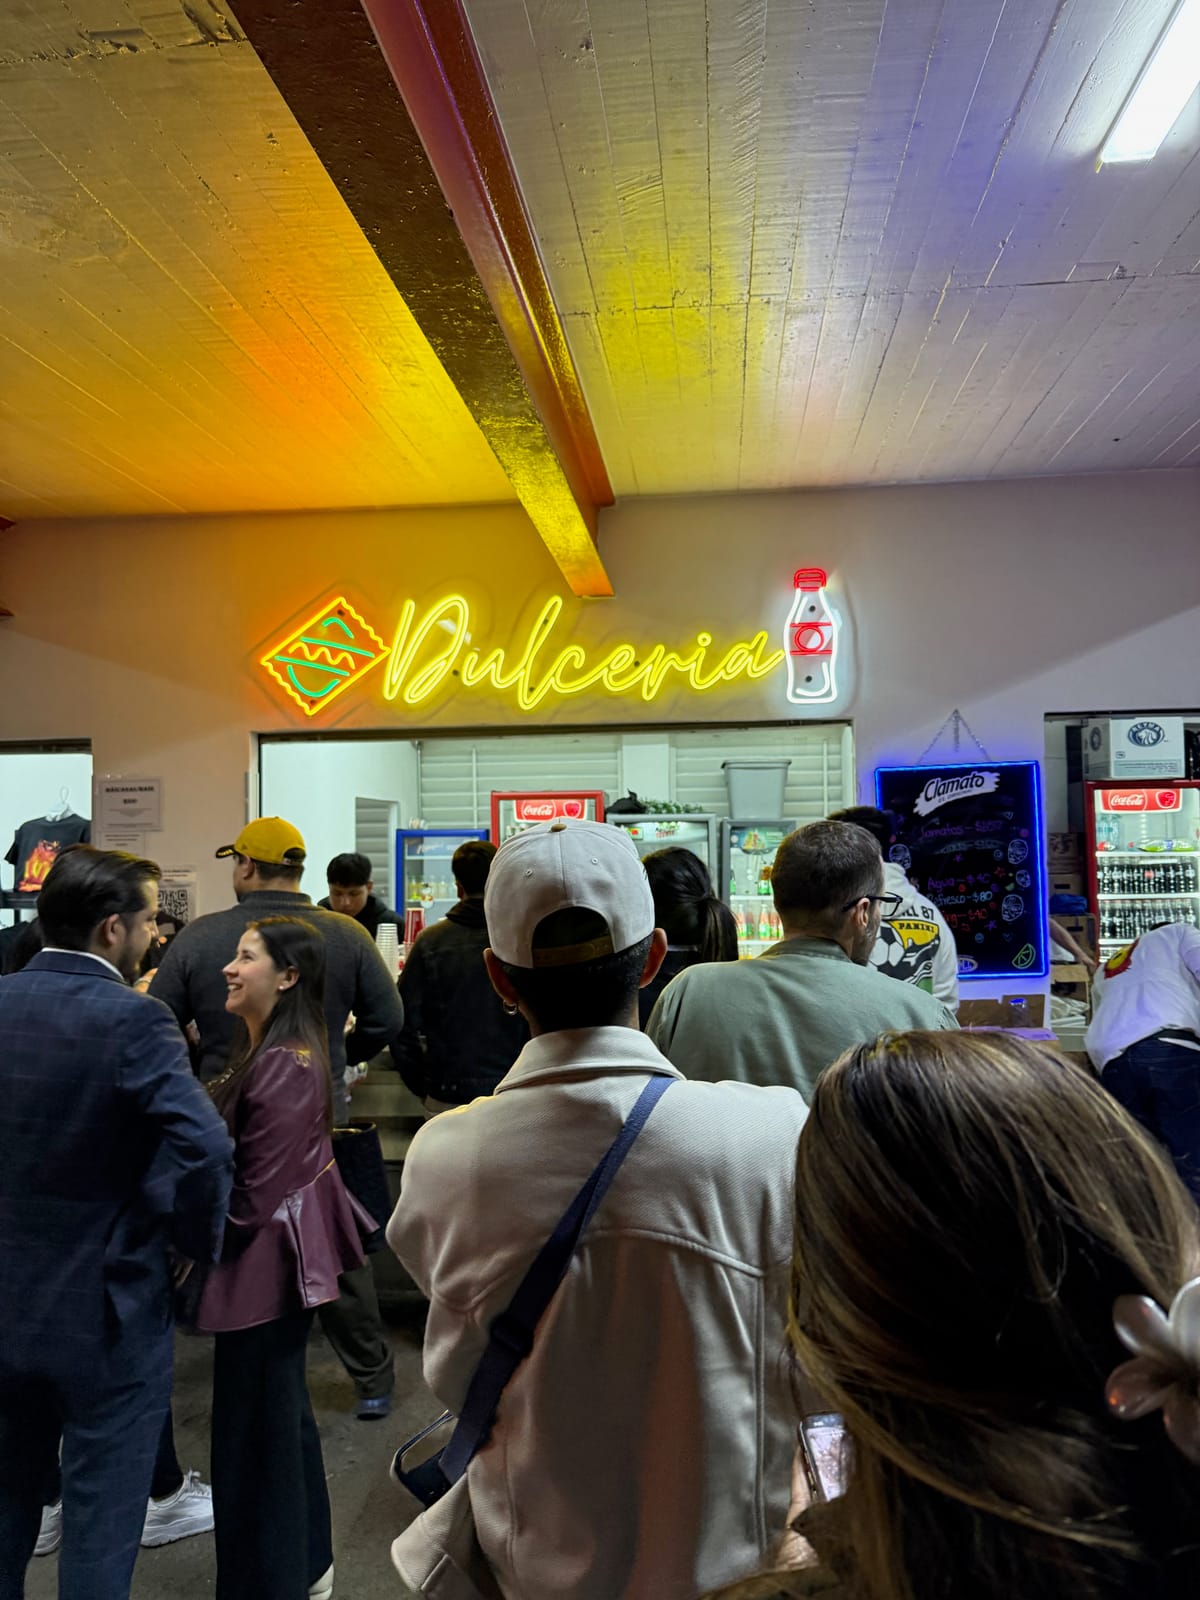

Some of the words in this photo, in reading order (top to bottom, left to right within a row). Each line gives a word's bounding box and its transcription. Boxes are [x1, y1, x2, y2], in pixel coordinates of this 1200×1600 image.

[383, 594, 786, 710] Dulceria
[924, 773, 985, 802] Clamato
[920, 905, 935, 920] 87
[898, 922, 935, 933] PANINI
